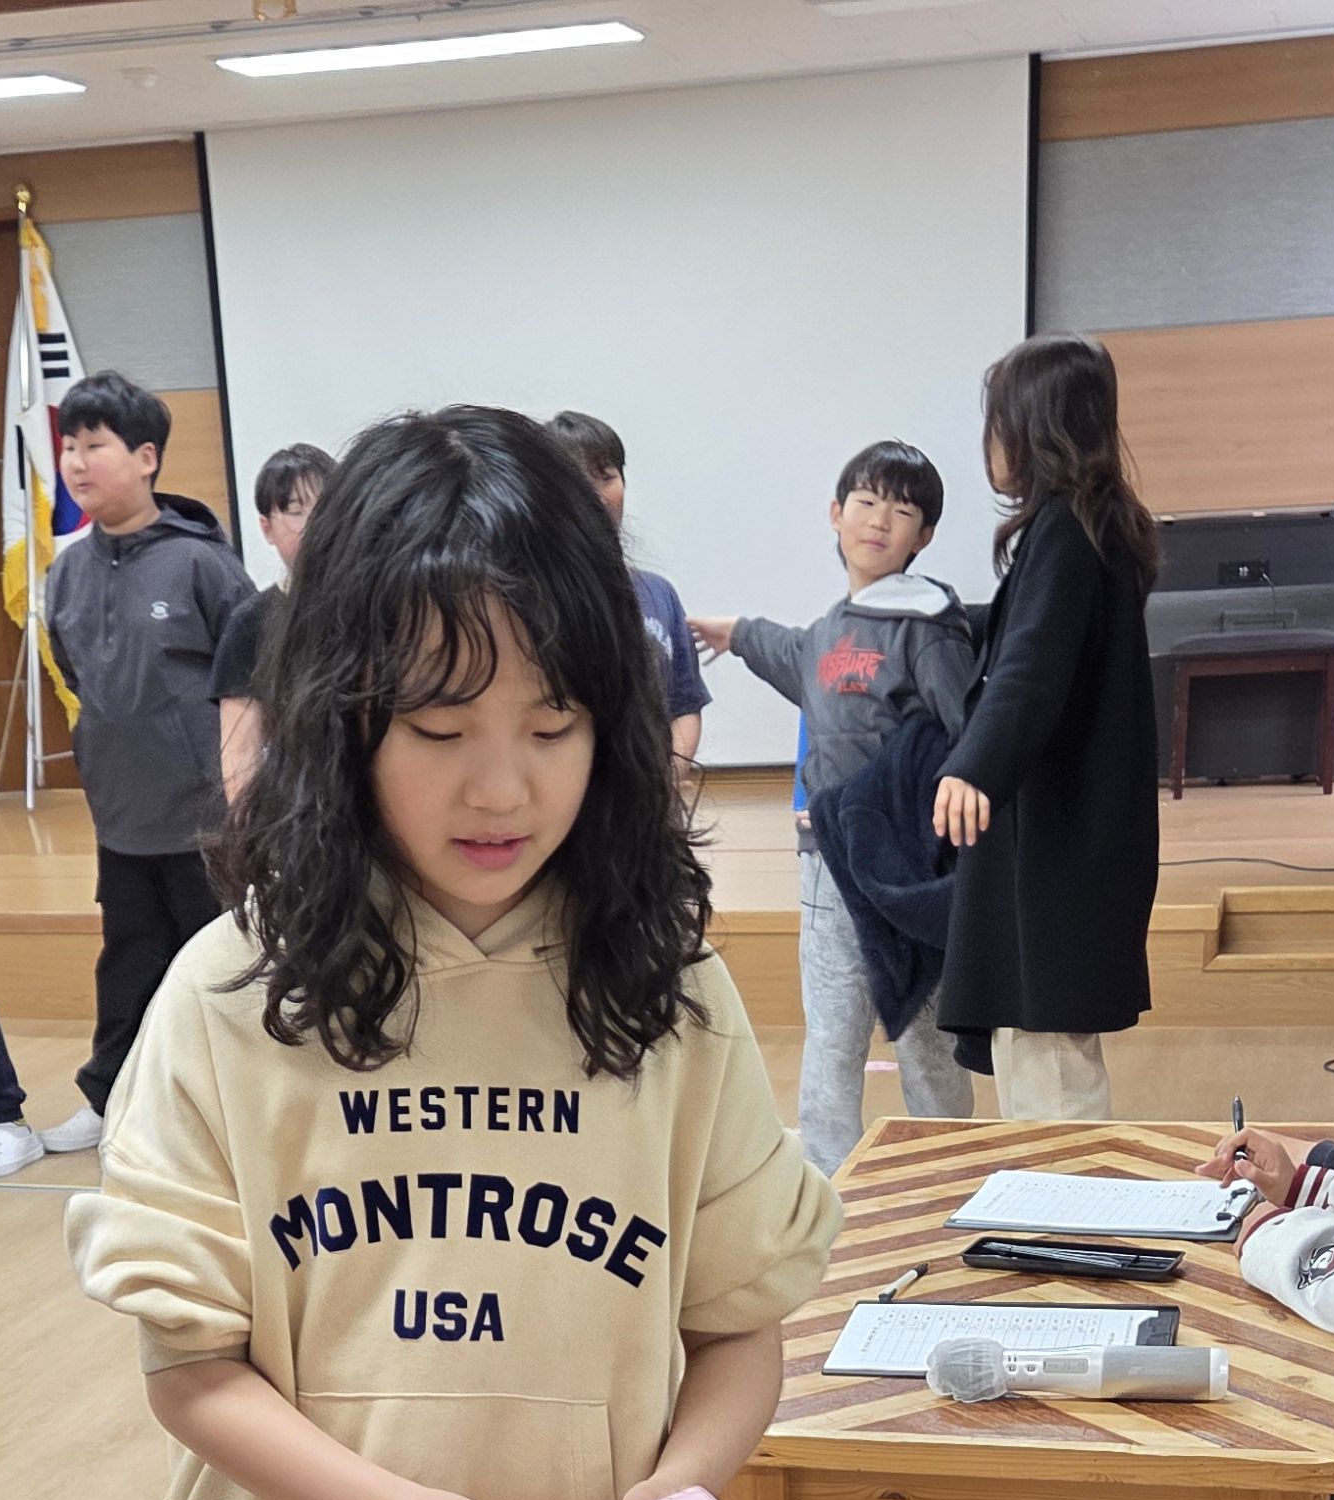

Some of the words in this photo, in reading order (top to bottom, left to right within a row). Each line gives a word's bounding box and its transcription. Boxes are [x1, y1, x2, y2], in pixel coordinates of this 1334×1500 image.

[338, 1085, 581, 1135] WESTERN
[269, 1173, 668, 1289] MONTROSE
[392, 1289, 505, 1342] USA
